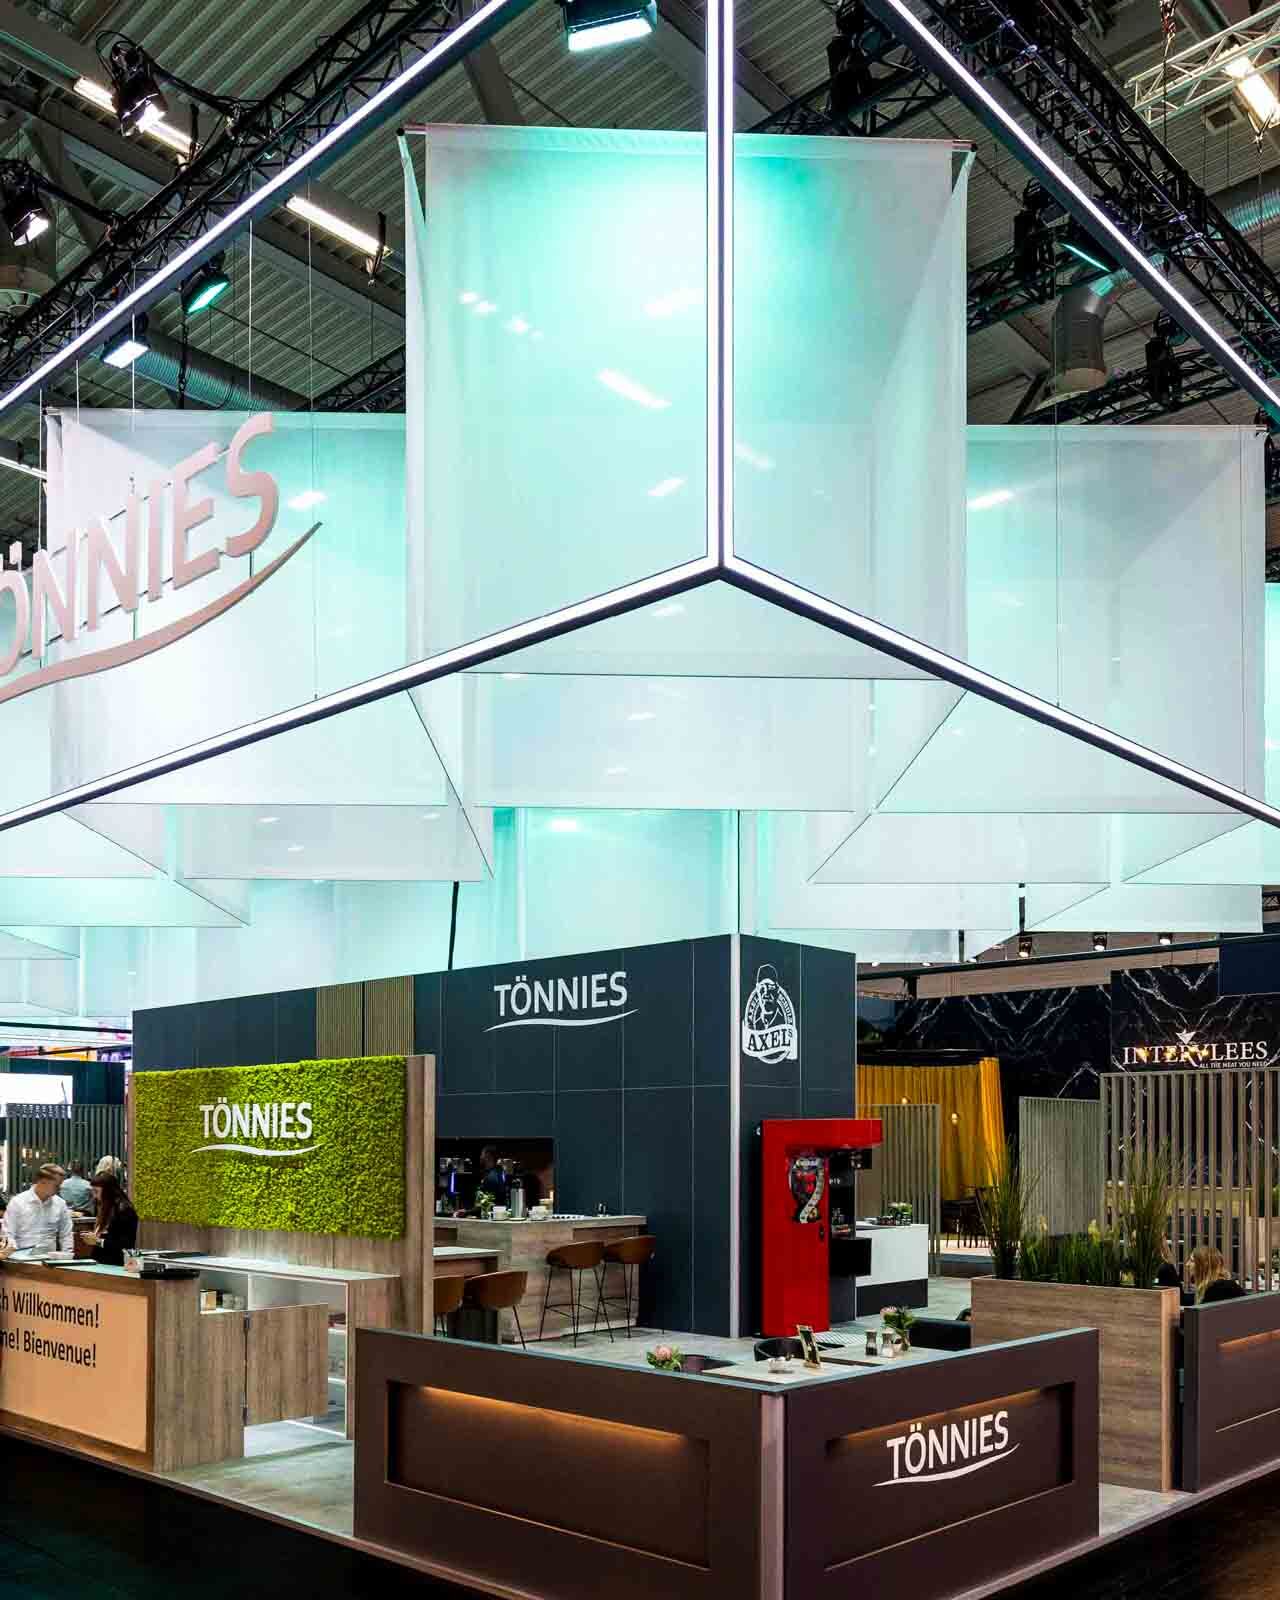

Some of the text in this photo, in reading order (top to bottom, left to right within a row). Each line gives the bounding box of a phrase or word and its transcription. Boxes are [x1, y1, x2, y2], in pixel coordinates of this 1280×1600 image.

[493, 971, 628, 1016] TÖNNIES
[1122, 1041, 1268, 1067] INTERVLEES
[199, 1096, 313, 1140] TÖNNIES
[12, 1290, 100, 1329] Willkommen!
[23, 1330, 97, 1369] Bienvenue!
[886, 1410, 1009, 1479] TÖNNIES
